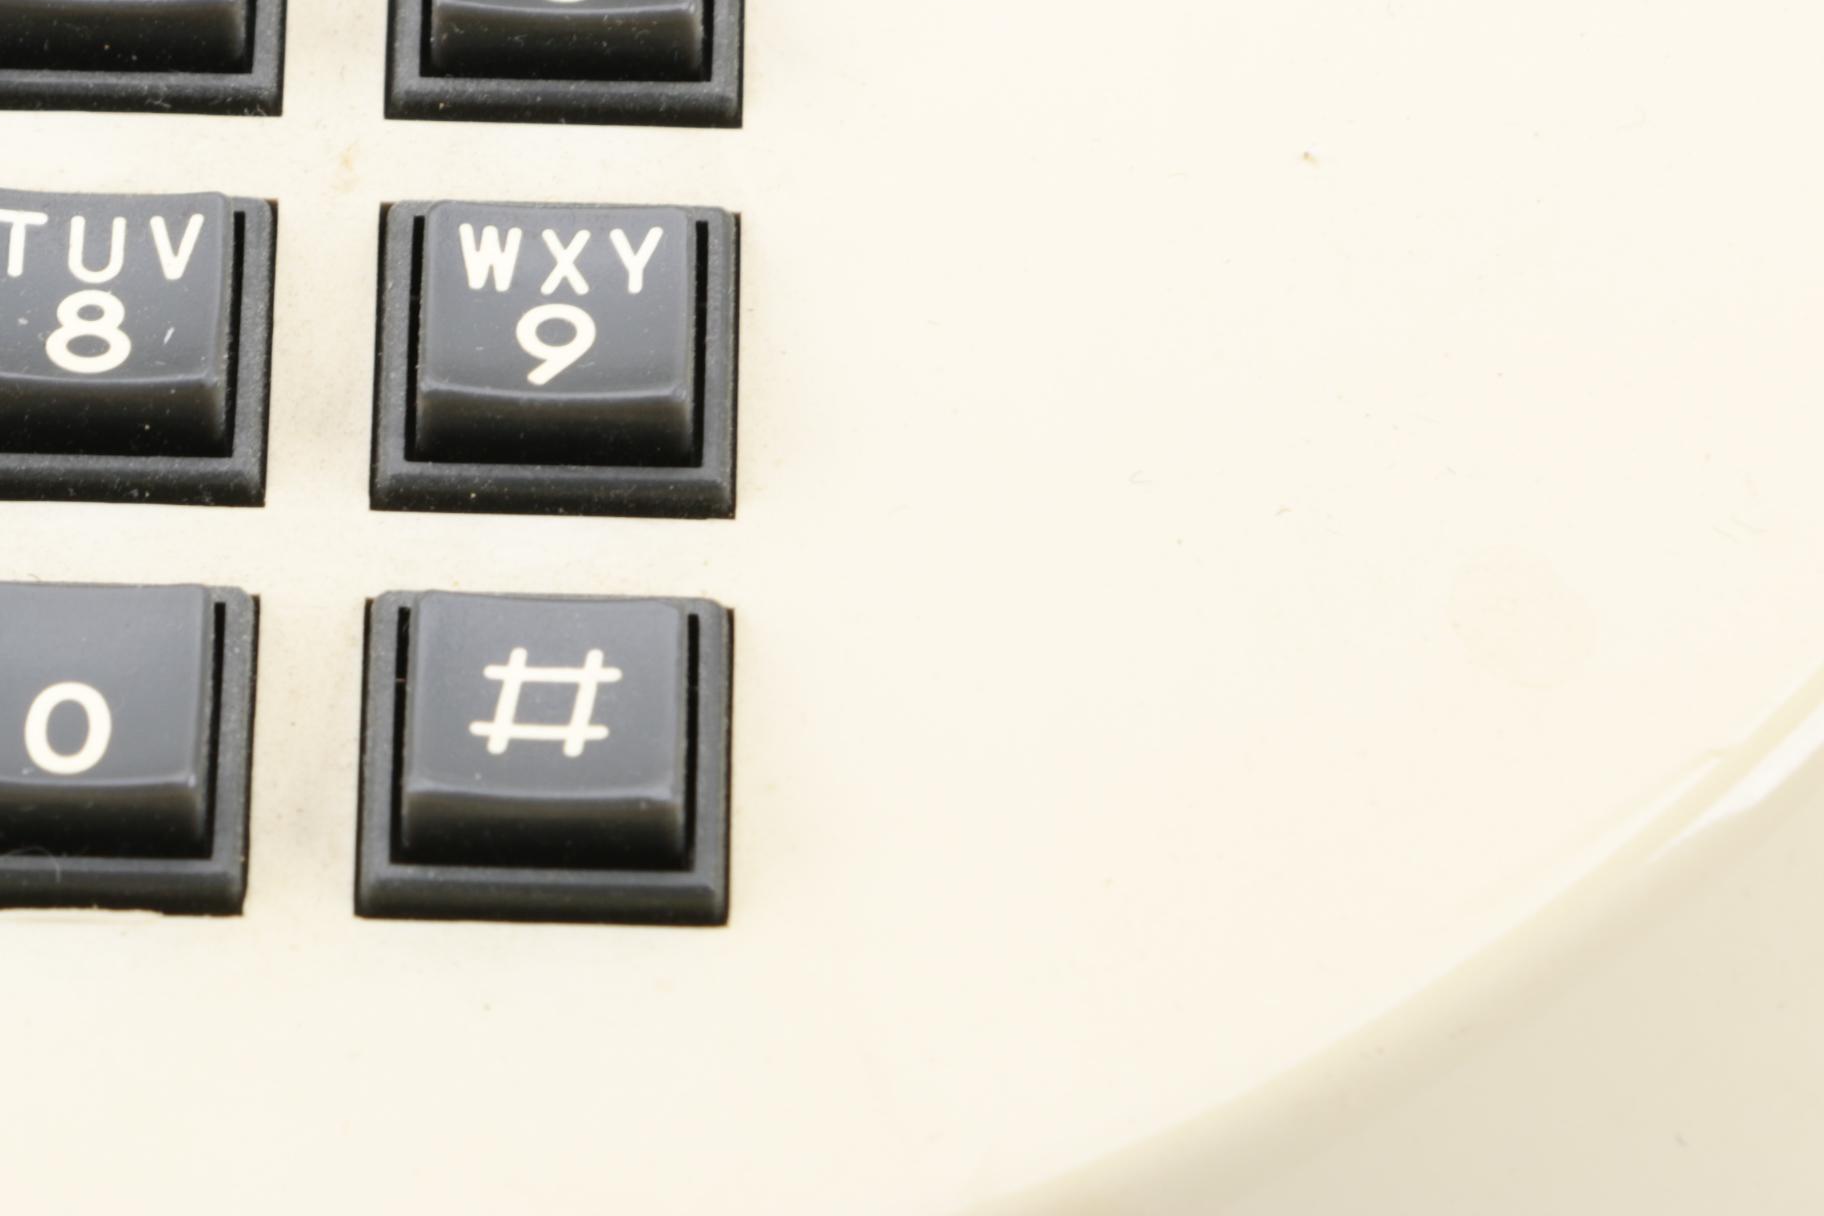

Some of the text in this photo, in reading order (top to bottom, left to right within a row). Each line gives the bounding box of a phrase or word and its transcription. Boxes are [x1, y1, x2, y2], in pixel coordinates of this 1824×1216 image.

[458, 222, 667, 297] WXY
[44, 288, 133, 375] 8
[514, 299, 598, 386] 9
[23, 679, 113, 776] 0
[468, 645, 624, 759] #
